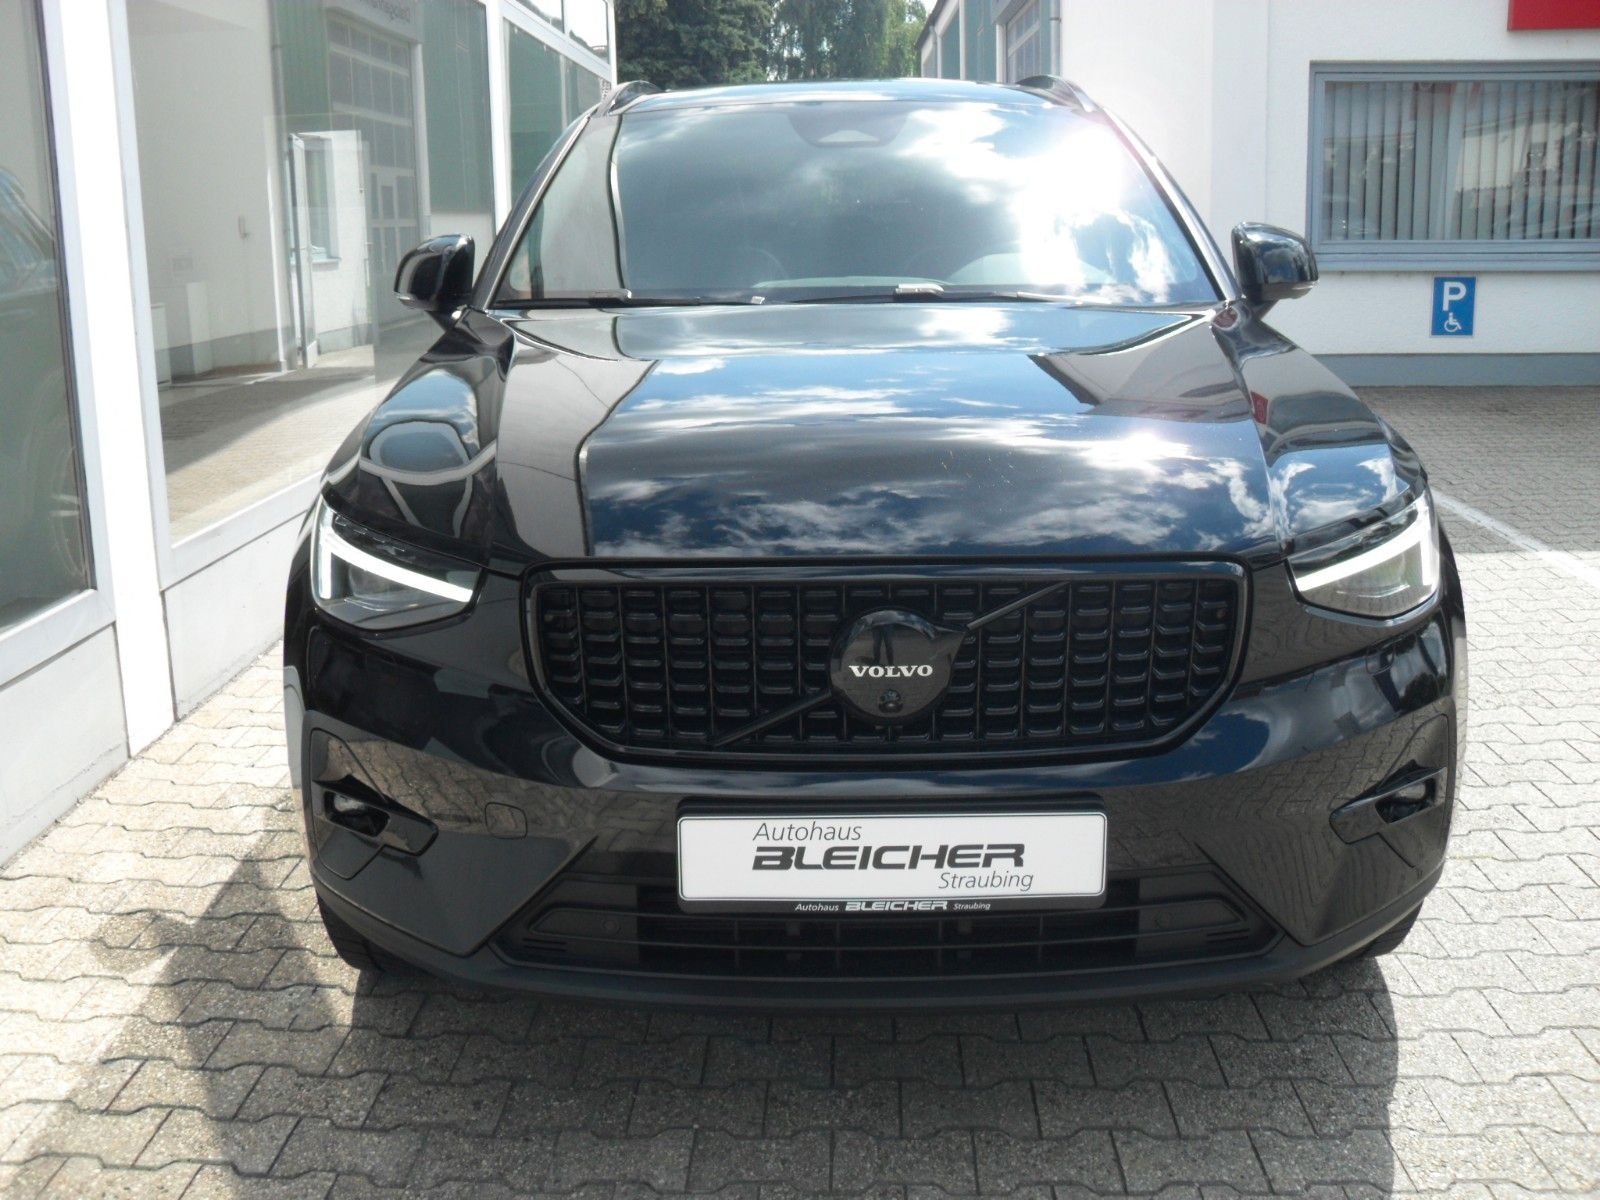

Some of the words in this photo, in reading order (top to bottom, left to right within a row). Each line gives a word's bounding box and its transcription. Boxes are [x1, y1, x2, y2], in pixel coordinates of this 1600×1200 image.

[1442, 281, 1467, 312] P
[849, 665, 933, 678] VOLVO
[752, 820, 862, 841] Autohaus
[751, 843, 1025, 871] BLEICHER
[938, 870, 1034, 892] Straubing
[794, 903, 840, 912] Autohaus
[845, 900, 948, 912] BLEICHER
[952, 902, 991, 911] Straubing
